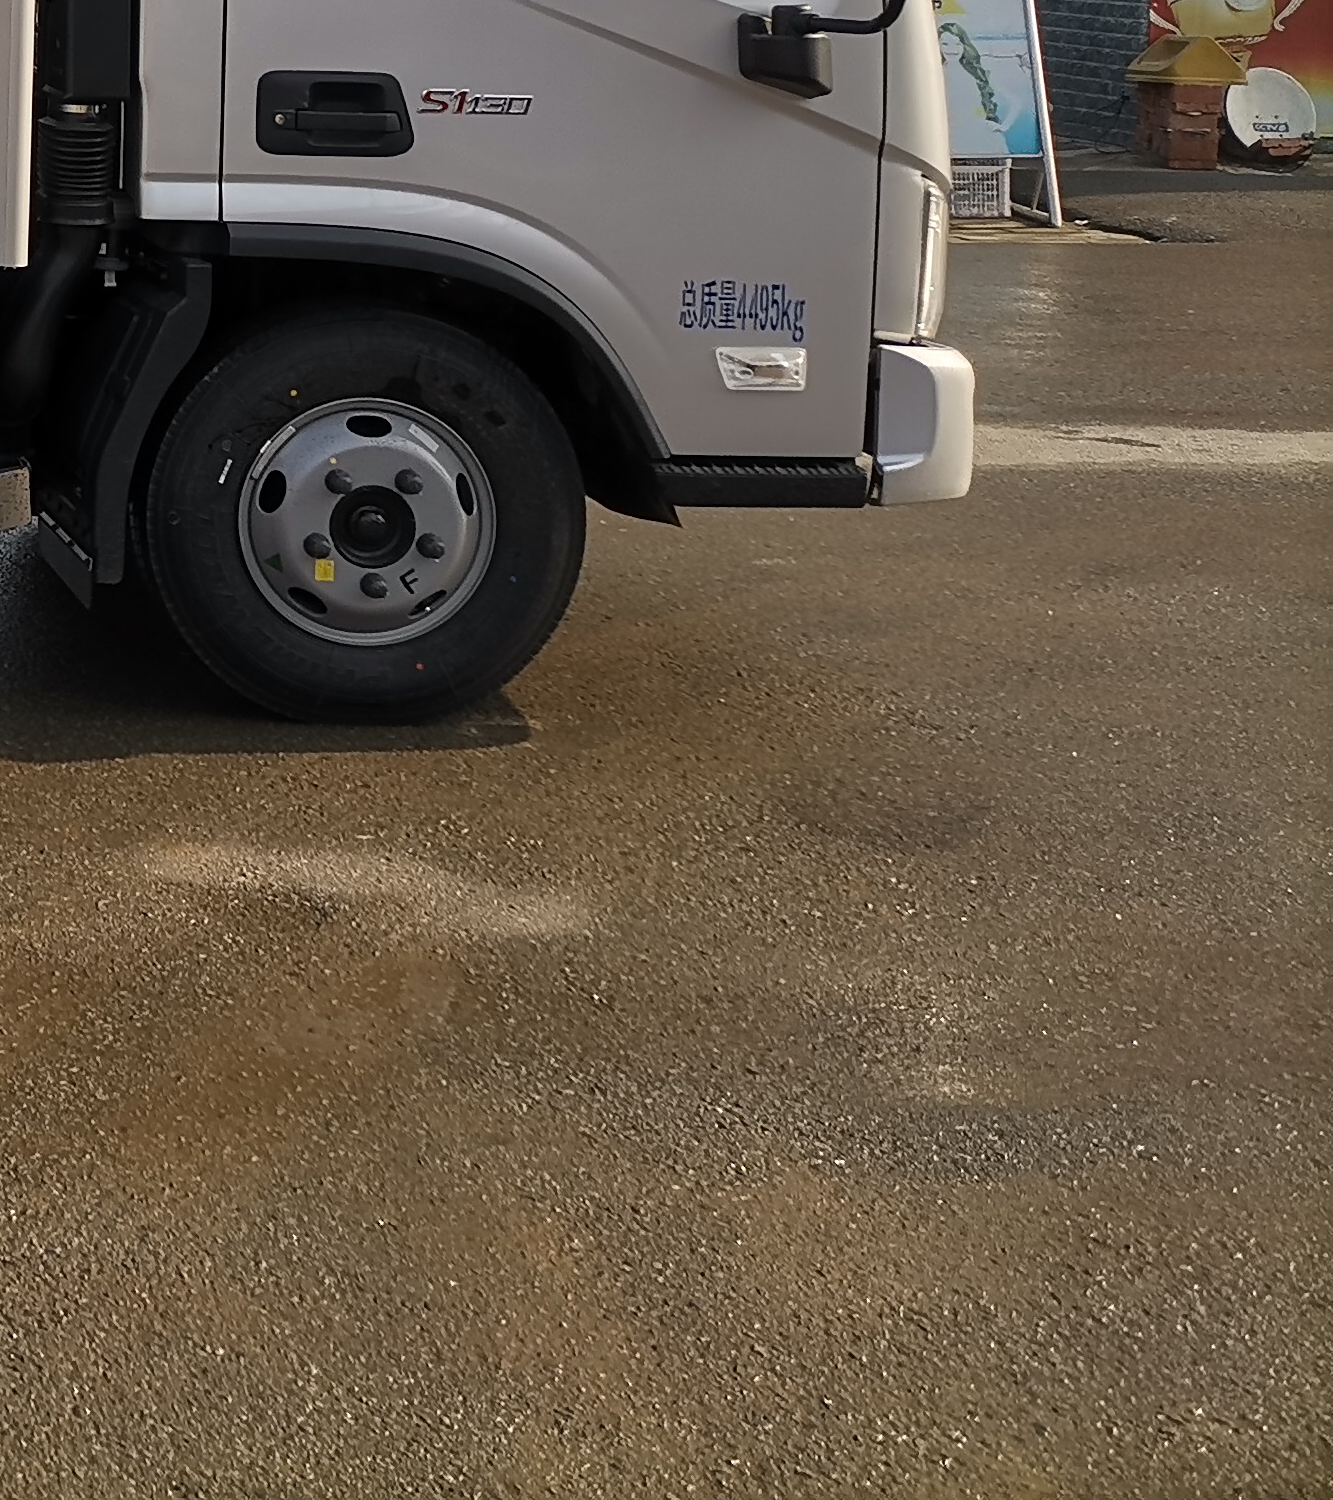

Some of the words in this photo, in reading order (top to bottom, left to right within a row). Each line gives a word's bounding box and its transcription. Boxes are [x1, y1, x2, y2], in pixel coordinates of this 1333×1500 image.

[679, 279, 806, 343] 总质量4495kg
[399, 567, 420, 595] F
